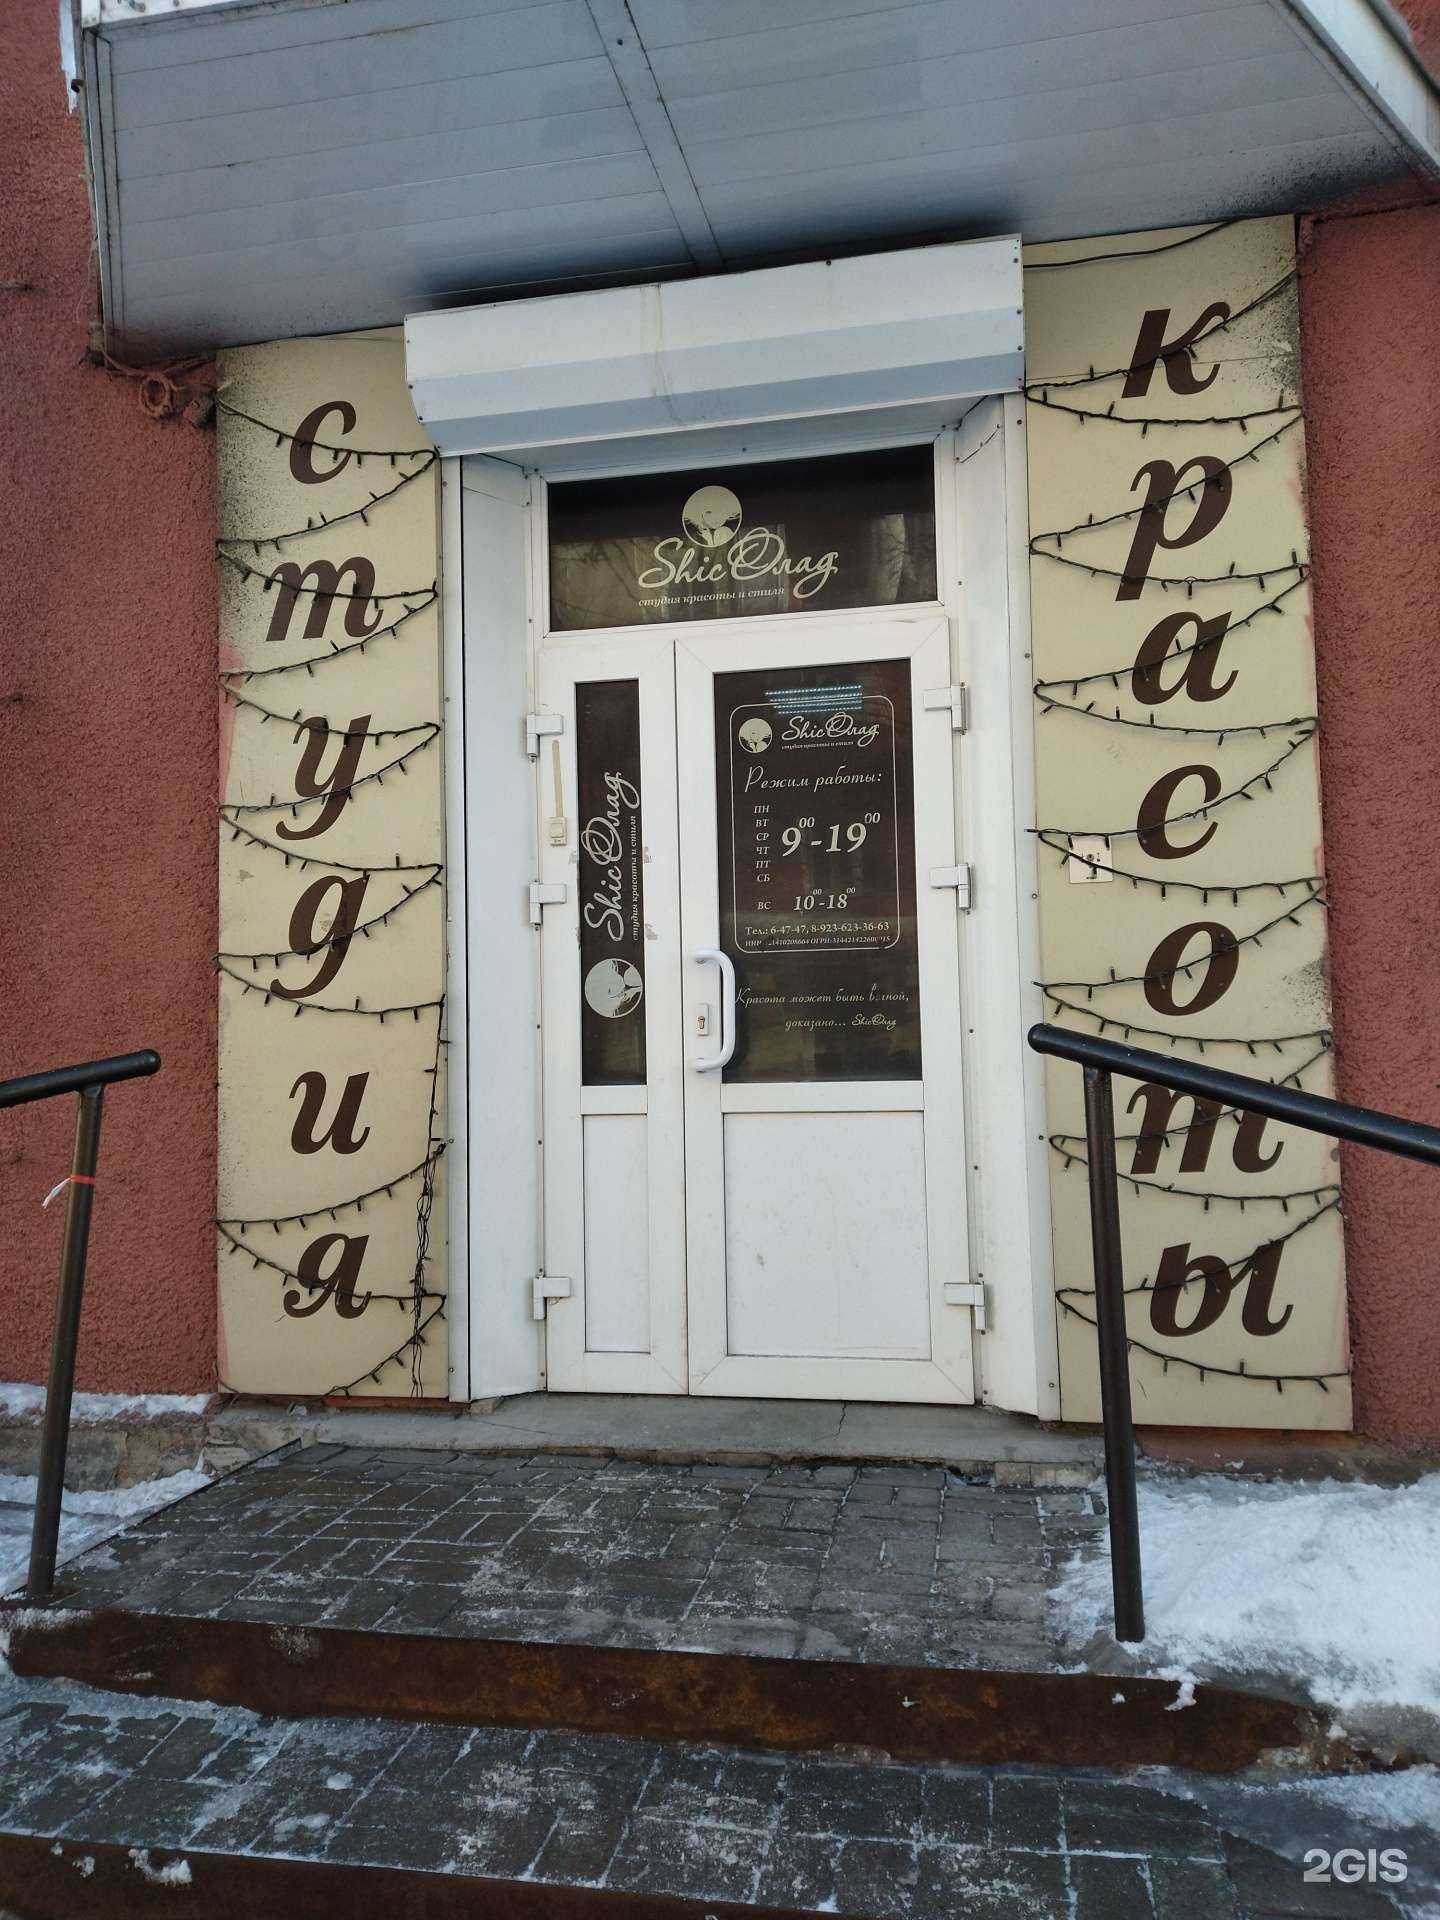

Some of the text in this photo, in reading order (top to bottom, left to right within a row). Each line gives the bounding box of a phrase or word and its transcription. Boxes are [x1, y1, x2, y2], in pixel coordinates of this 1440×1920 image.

[638, 587, 785, 608] студия красоты и стиля
[745, 764, 882, 793] Режим работы:
[753, 804, 770, 814] ПН
[755, 818, 770, 828] ВТ
[630, 815, 638, 848] стиля
[756, 832, 770, 841] СР
[756, 846, 770, 855] ЧТ
[265, 400, 385, 1320] студия
[755, 860, 771, 869] ПТ
[629, 857, 640, 903] красоты
[756, 873, 771, 882] СБ
[757, 901, 772, 910] ВС
[630, 902, 641, 941] студия
[735, 987, 786, 1009] Красота
[835, 988, 865, 1002] быть
